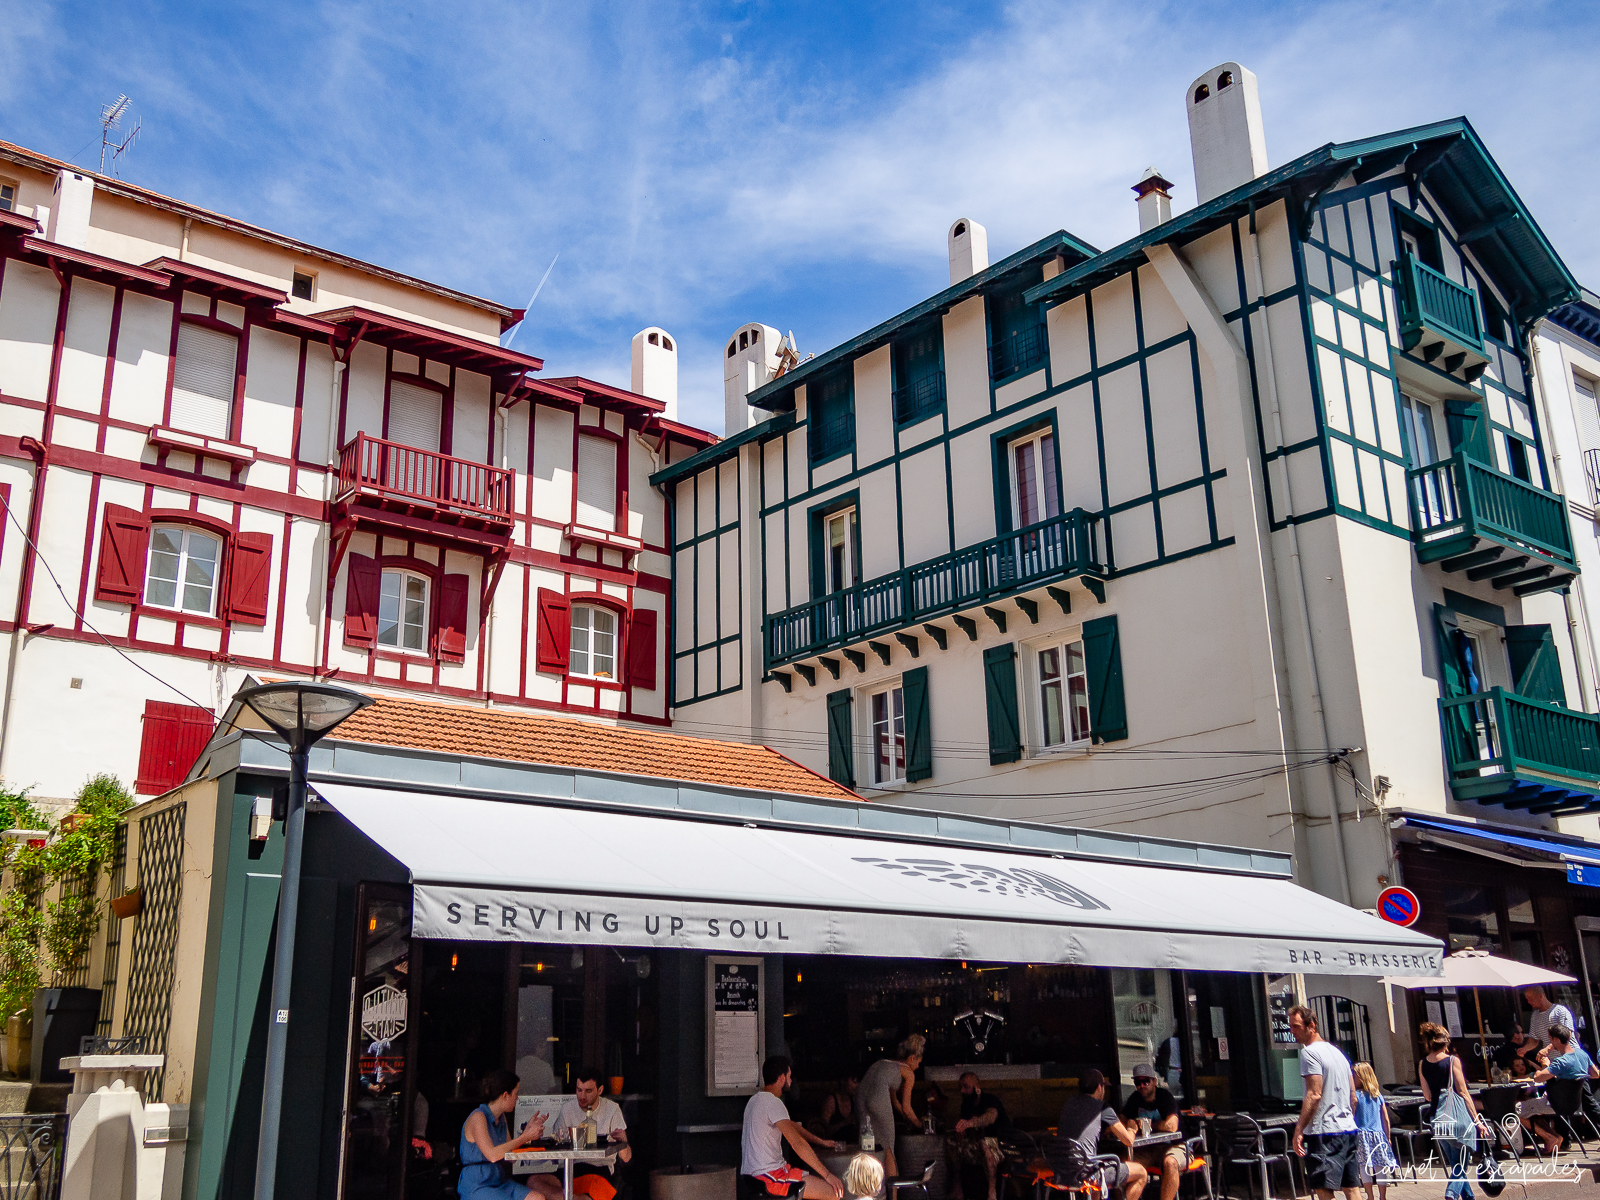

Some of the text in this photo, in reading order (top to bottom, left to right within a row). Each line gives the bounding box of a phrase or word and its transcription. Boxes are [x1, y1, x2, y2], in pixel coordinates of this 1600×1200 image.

[446, 902, 789, 941] SERVING UP SOUL
[1288, 949, 1323, 965] BAR
[1347, 952, 1438, 969] BRASSERIE
